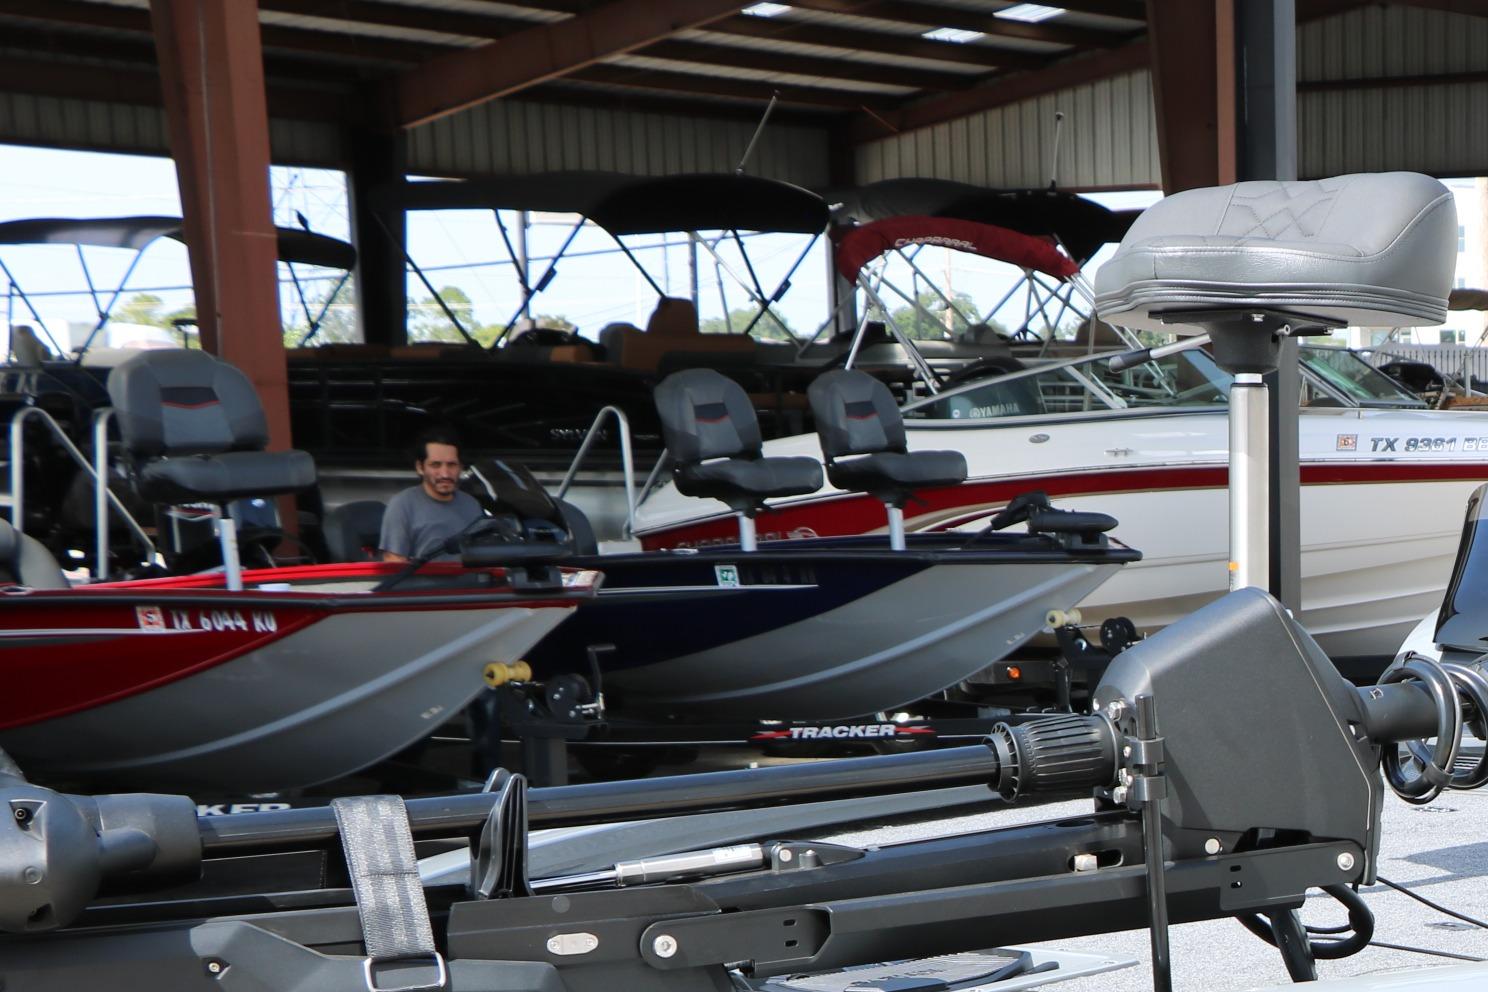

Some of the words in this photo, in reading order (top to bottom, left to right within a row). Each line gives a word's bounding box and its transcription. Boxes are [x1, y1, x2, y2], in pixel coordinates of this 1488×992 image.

[980, 403, 1019, 417] YAMAHA
[1370, 437, 1399, 452] TX
[200, 611, 248, 631] 6044
[790, 724, 897, 739] TRACKER
